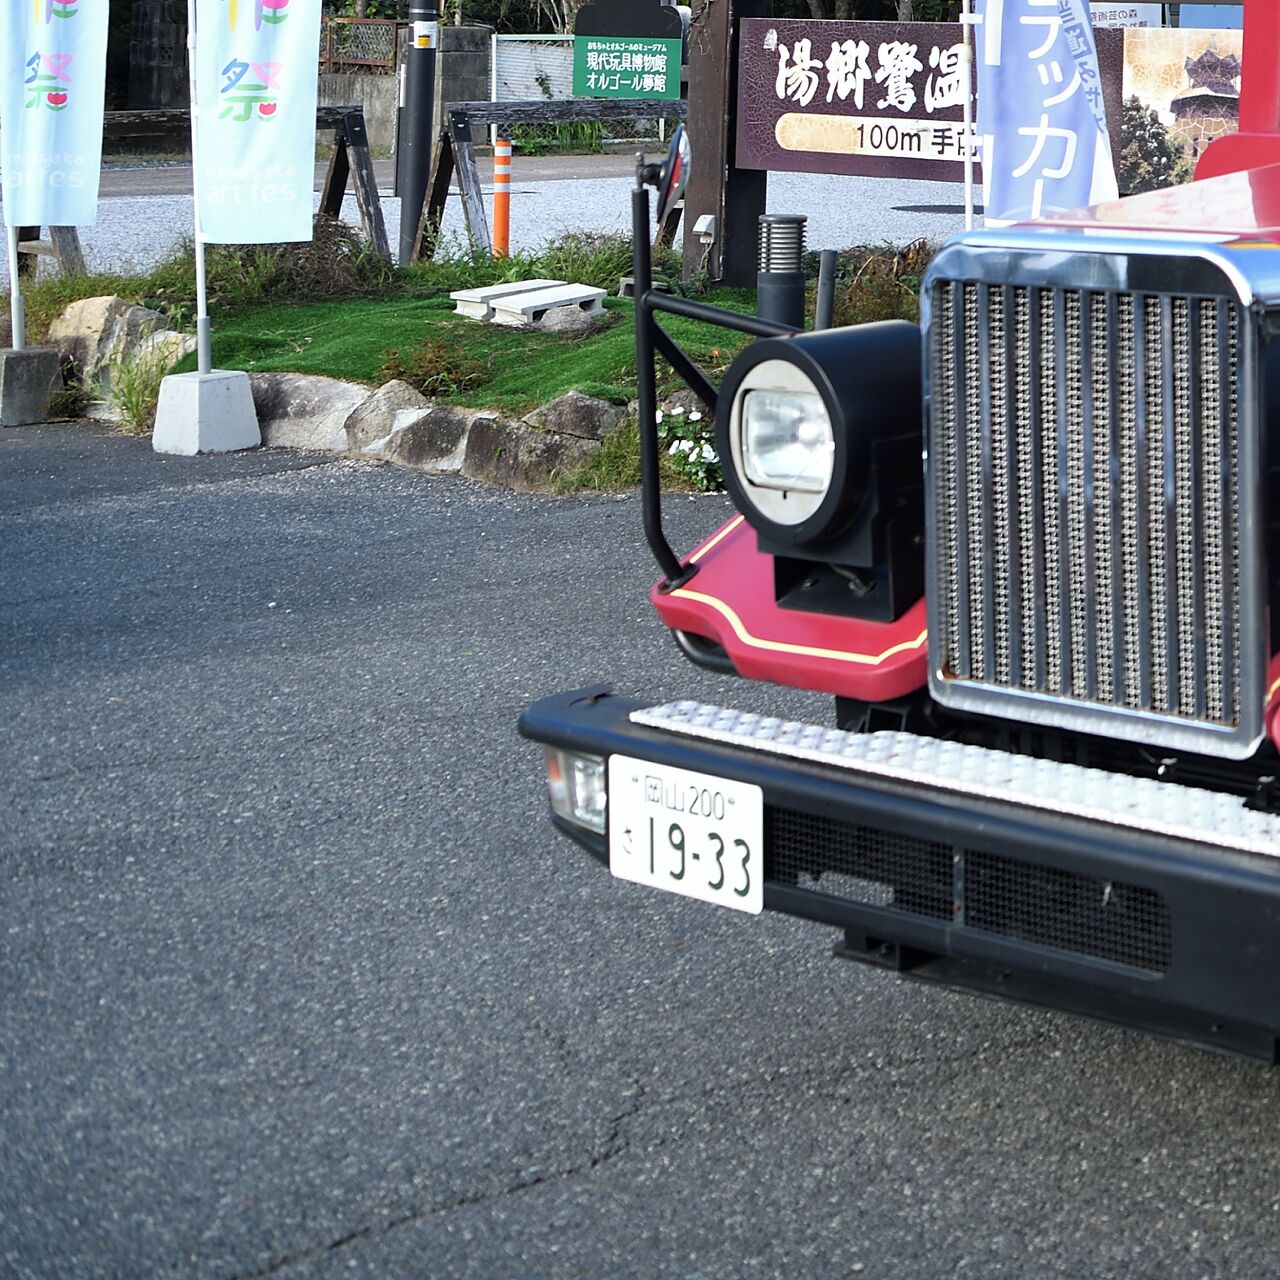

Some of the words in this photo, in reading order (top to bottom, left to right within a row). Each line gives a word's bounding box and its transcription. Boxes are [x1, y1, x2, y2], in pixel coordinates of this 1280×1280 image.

[586, 52, 667, 72] 現代玩具博物館
[775, 38, 970, 113] 湯郷鷺温
[586, 72, 667, 92] オルゴール夢館
[857, 123, 922, 152] 100m
[649, 817, 751, 898] 19-33
